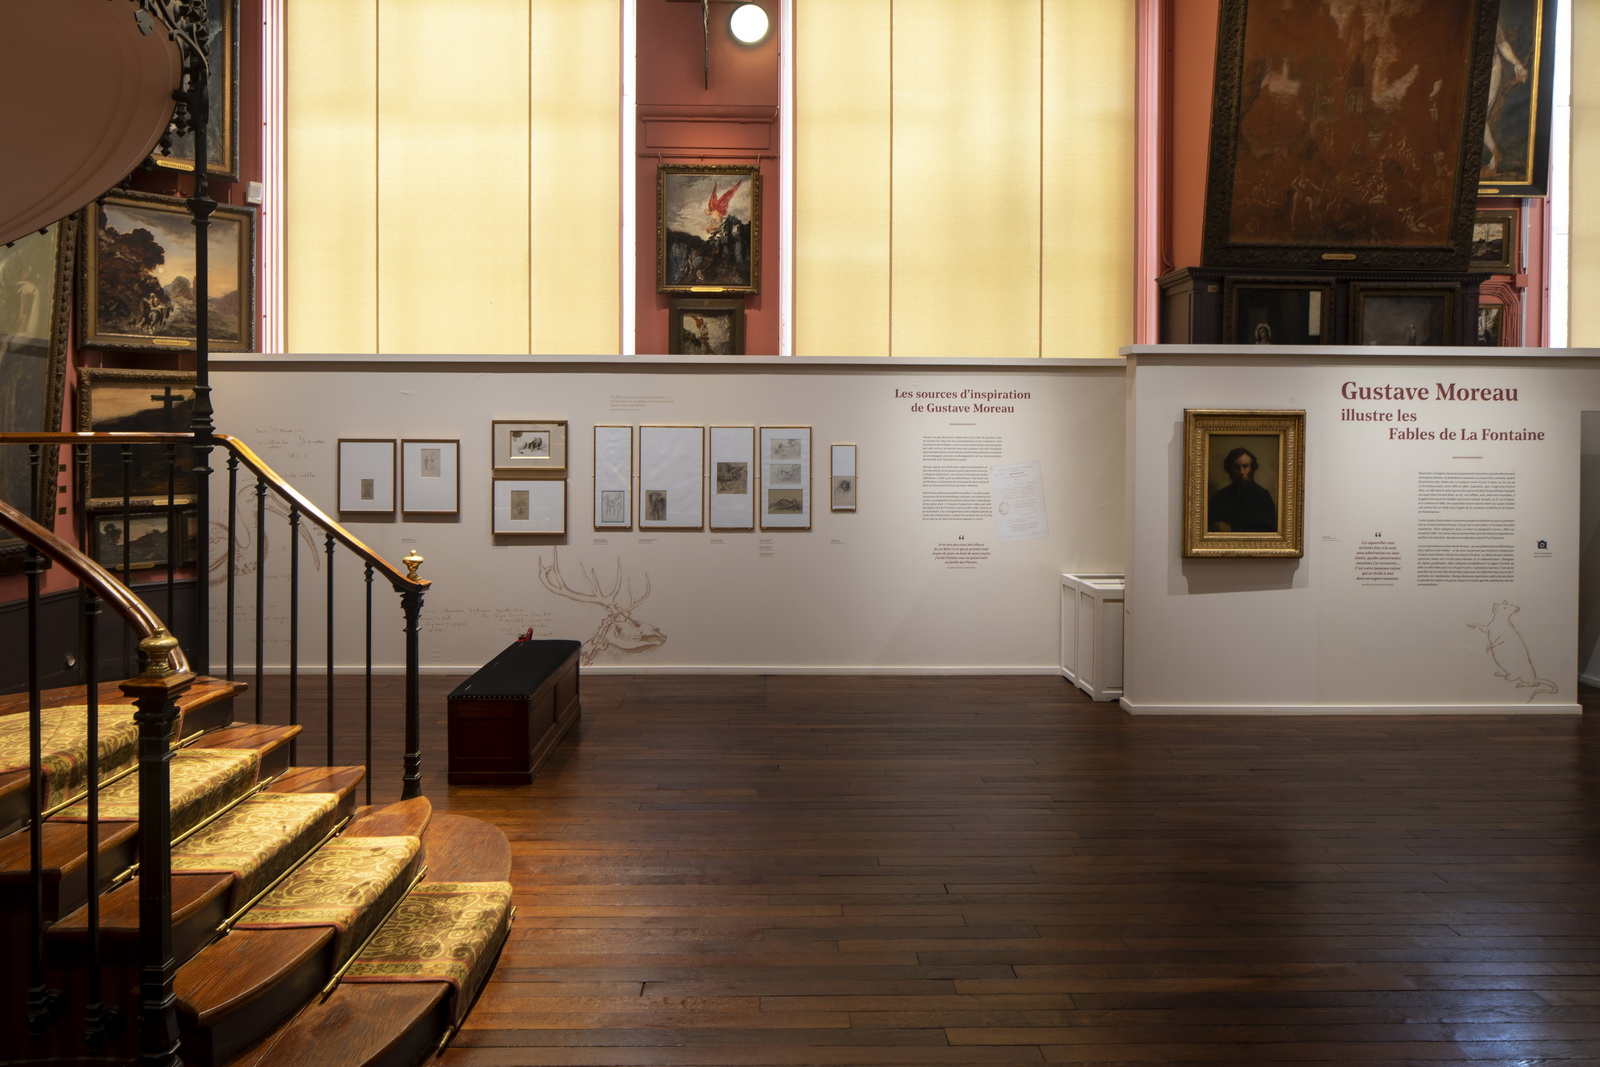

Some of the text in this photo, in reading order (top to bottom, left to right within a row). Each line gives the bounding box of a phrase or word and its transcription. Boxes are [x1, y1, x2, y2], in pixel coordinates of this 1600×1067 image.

[895, 389, 913, 399] Les
[1341, 382, 1518, 401] Gustave Moreau
[911, 403, 1014, 414] de Gustave Moreau
[1341, 409, 1417, 421] illustre les
[1389, 428, 1545, 441] Fables de La Fontaine
